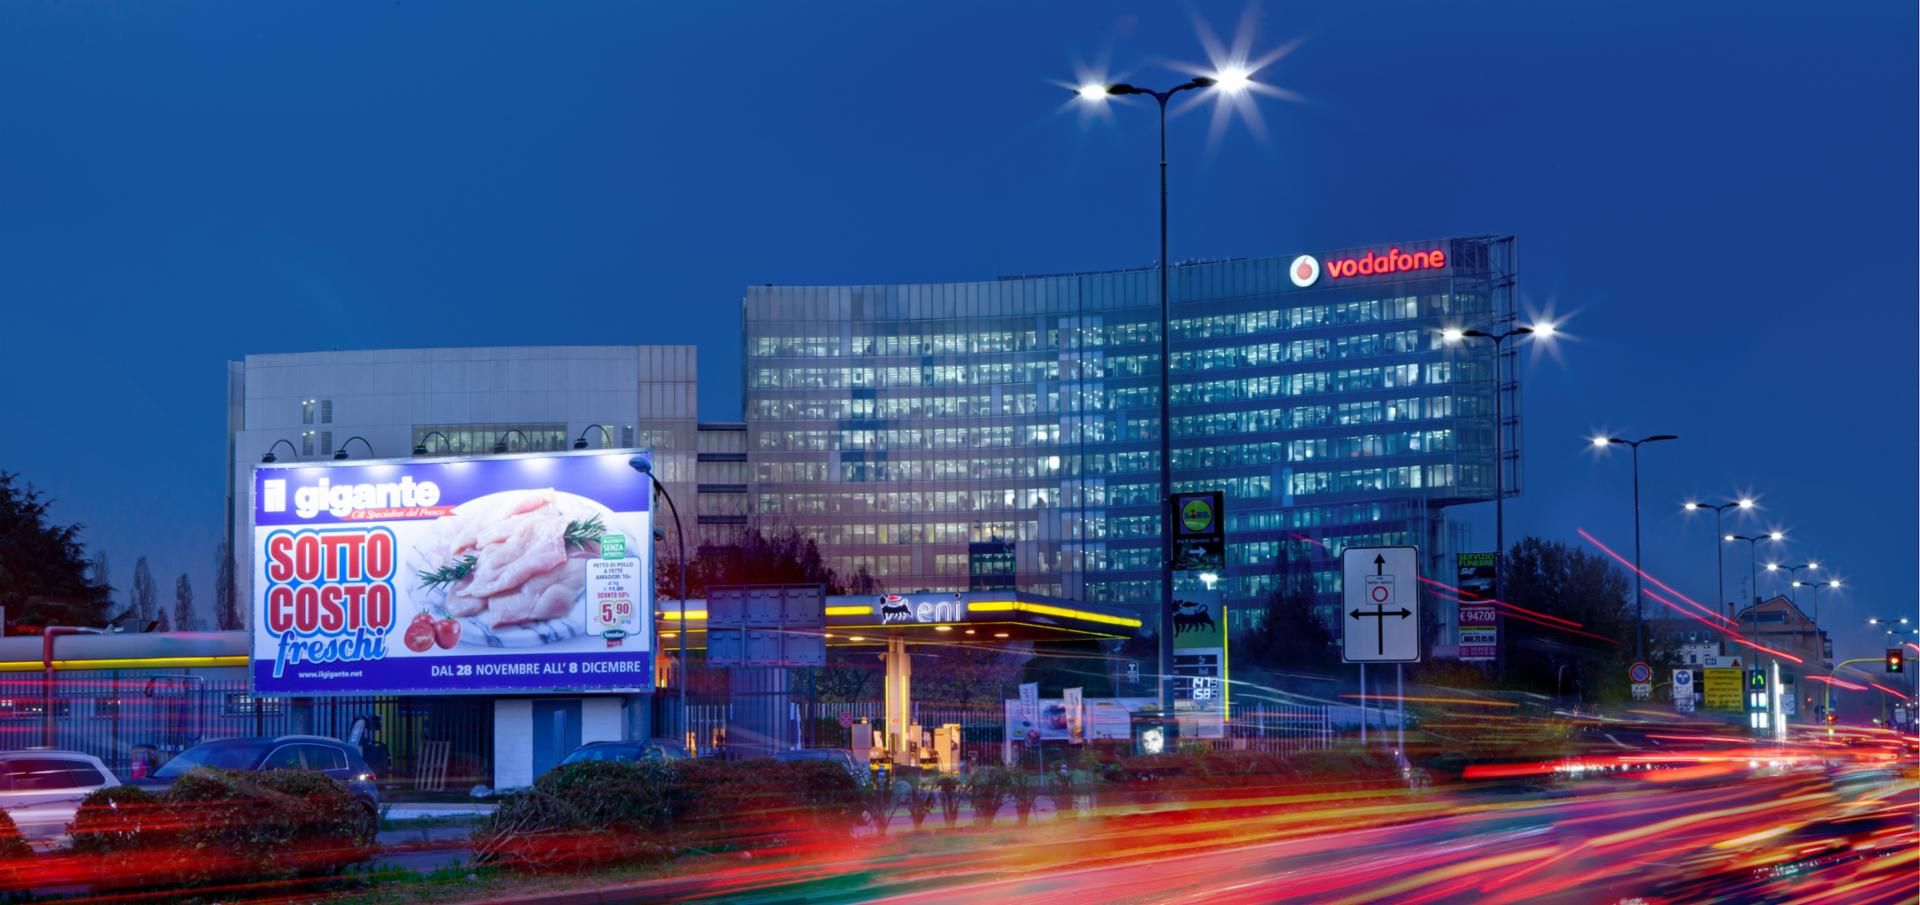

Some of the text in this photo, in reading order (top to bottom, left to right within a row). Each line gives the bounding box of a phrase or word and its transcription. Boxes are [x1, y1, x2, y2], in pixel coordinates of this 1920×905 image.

[1327, 249, 1445, 278] vodafone
[264, 476, 440, 518] il gigante
[406, 507, 418, 517] del
[270, 533, 391, 581] SOTTO
[270, 584, 391, 632] COSTO
[917, 593, 961, 623] eni
[273, 627, 387, 678] freschi
[298, 671, 363, 679] www.ilgigante.net
[431, 665, 454, 676] DAL
[456, 665, 472, 676] 28
[476, 663, 540, 675] NOVEMBRE
[569, 662, 578, 673] 8
[582, 661, 641, 673] DICEMBRE
